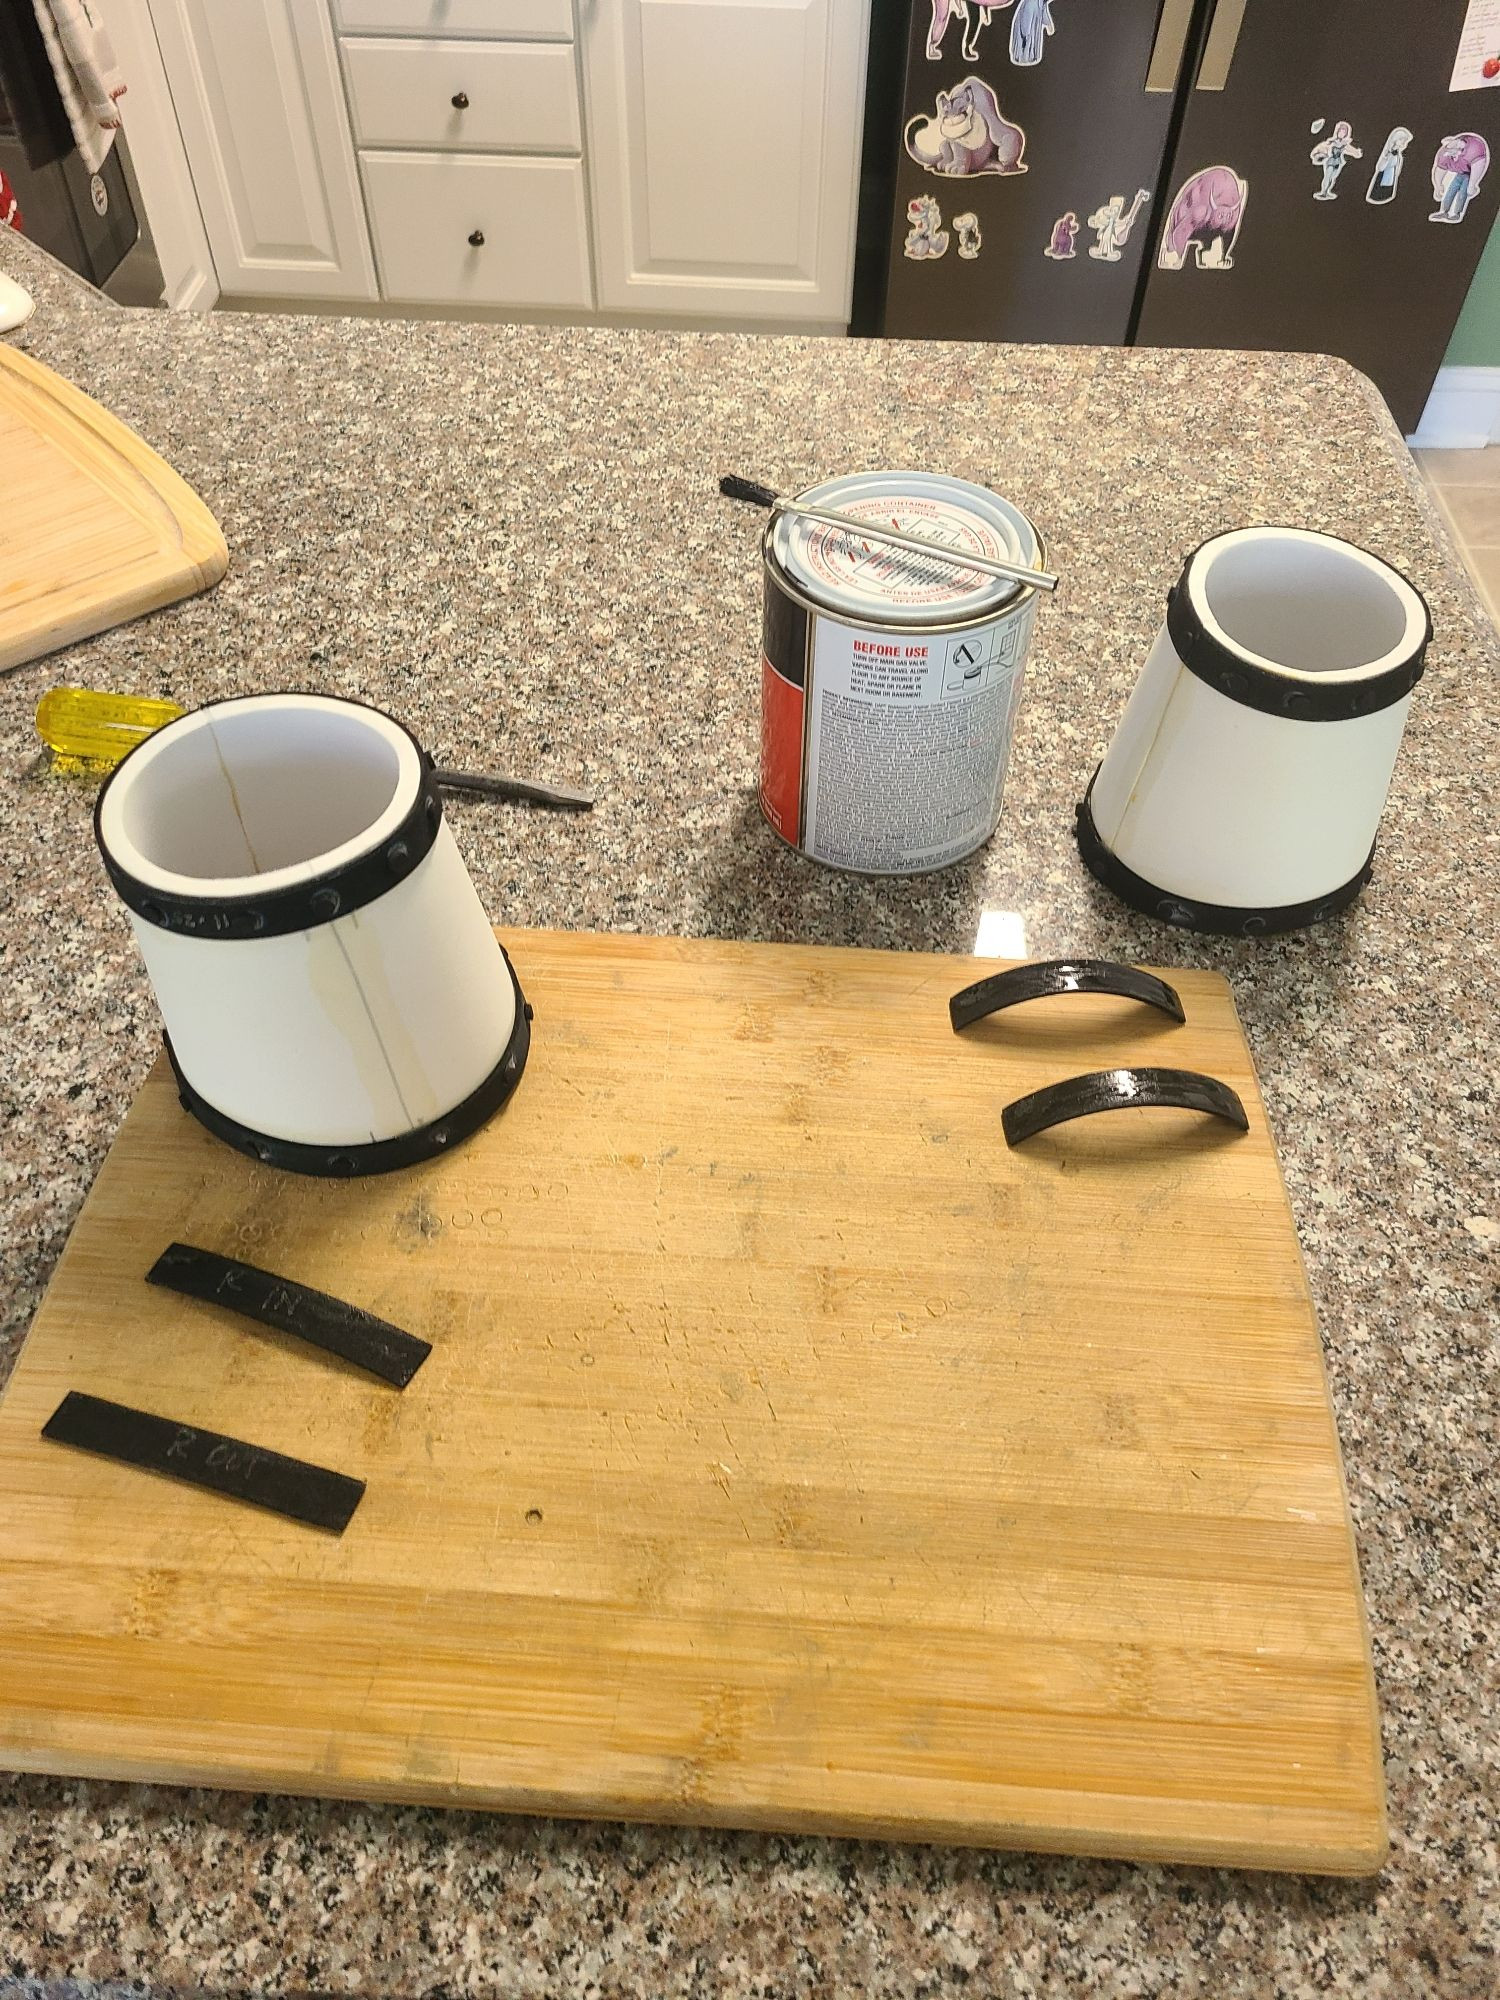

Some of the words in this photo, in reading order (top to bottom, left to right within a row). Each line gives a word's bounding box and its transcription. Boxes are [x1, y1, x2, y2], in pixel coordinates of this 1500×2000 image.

[853, 640, 900, 657] BEFORE
[905, 646, 929, 657] USE
[852, 669, 868, 678] FLOOR
